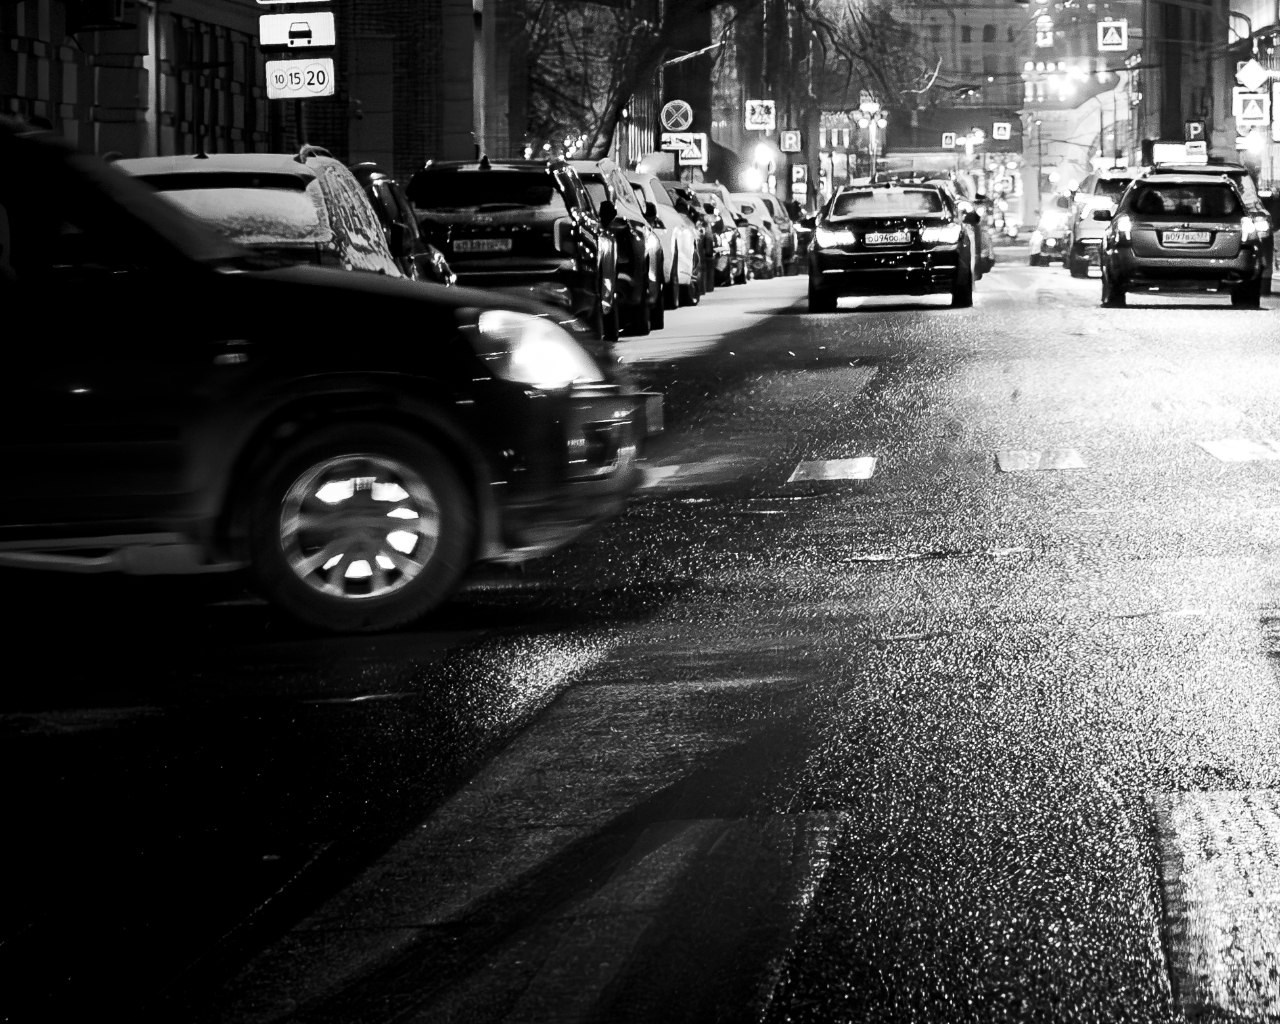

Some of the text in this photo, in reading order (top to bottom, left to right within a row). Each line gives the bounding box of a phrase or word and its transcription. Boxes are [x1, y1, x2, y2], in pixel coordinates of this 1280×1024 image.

[274, 70, 325, 86] 10 15 20
[1190, 122, 1202, 139] P
